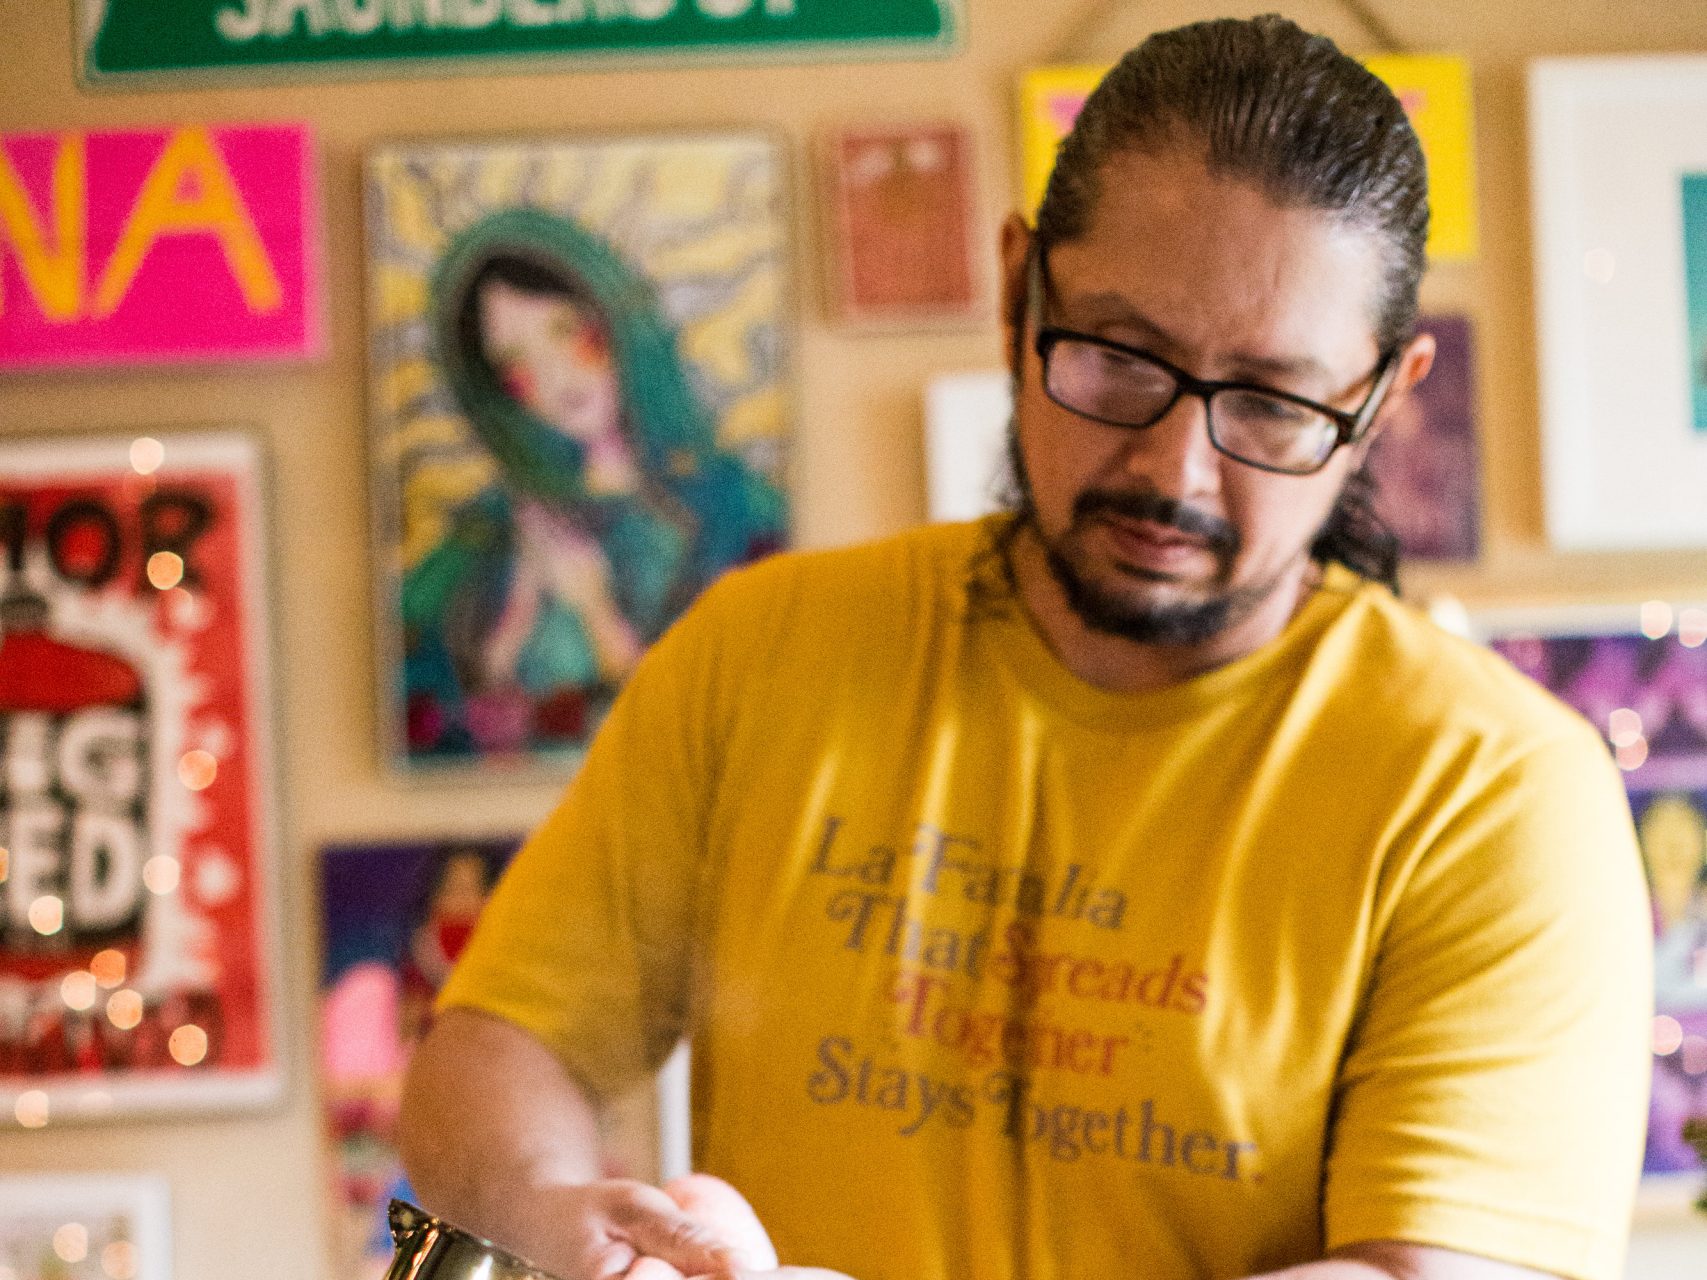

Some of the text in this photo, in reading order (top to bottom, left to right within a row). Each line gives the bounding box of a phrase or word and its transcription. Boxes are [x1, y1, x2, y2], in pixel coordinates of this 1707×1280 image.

[808, 815, 897, 886] La
[824, 888, 990, 982] That
[806, 1035, 976, 1138] Stays
